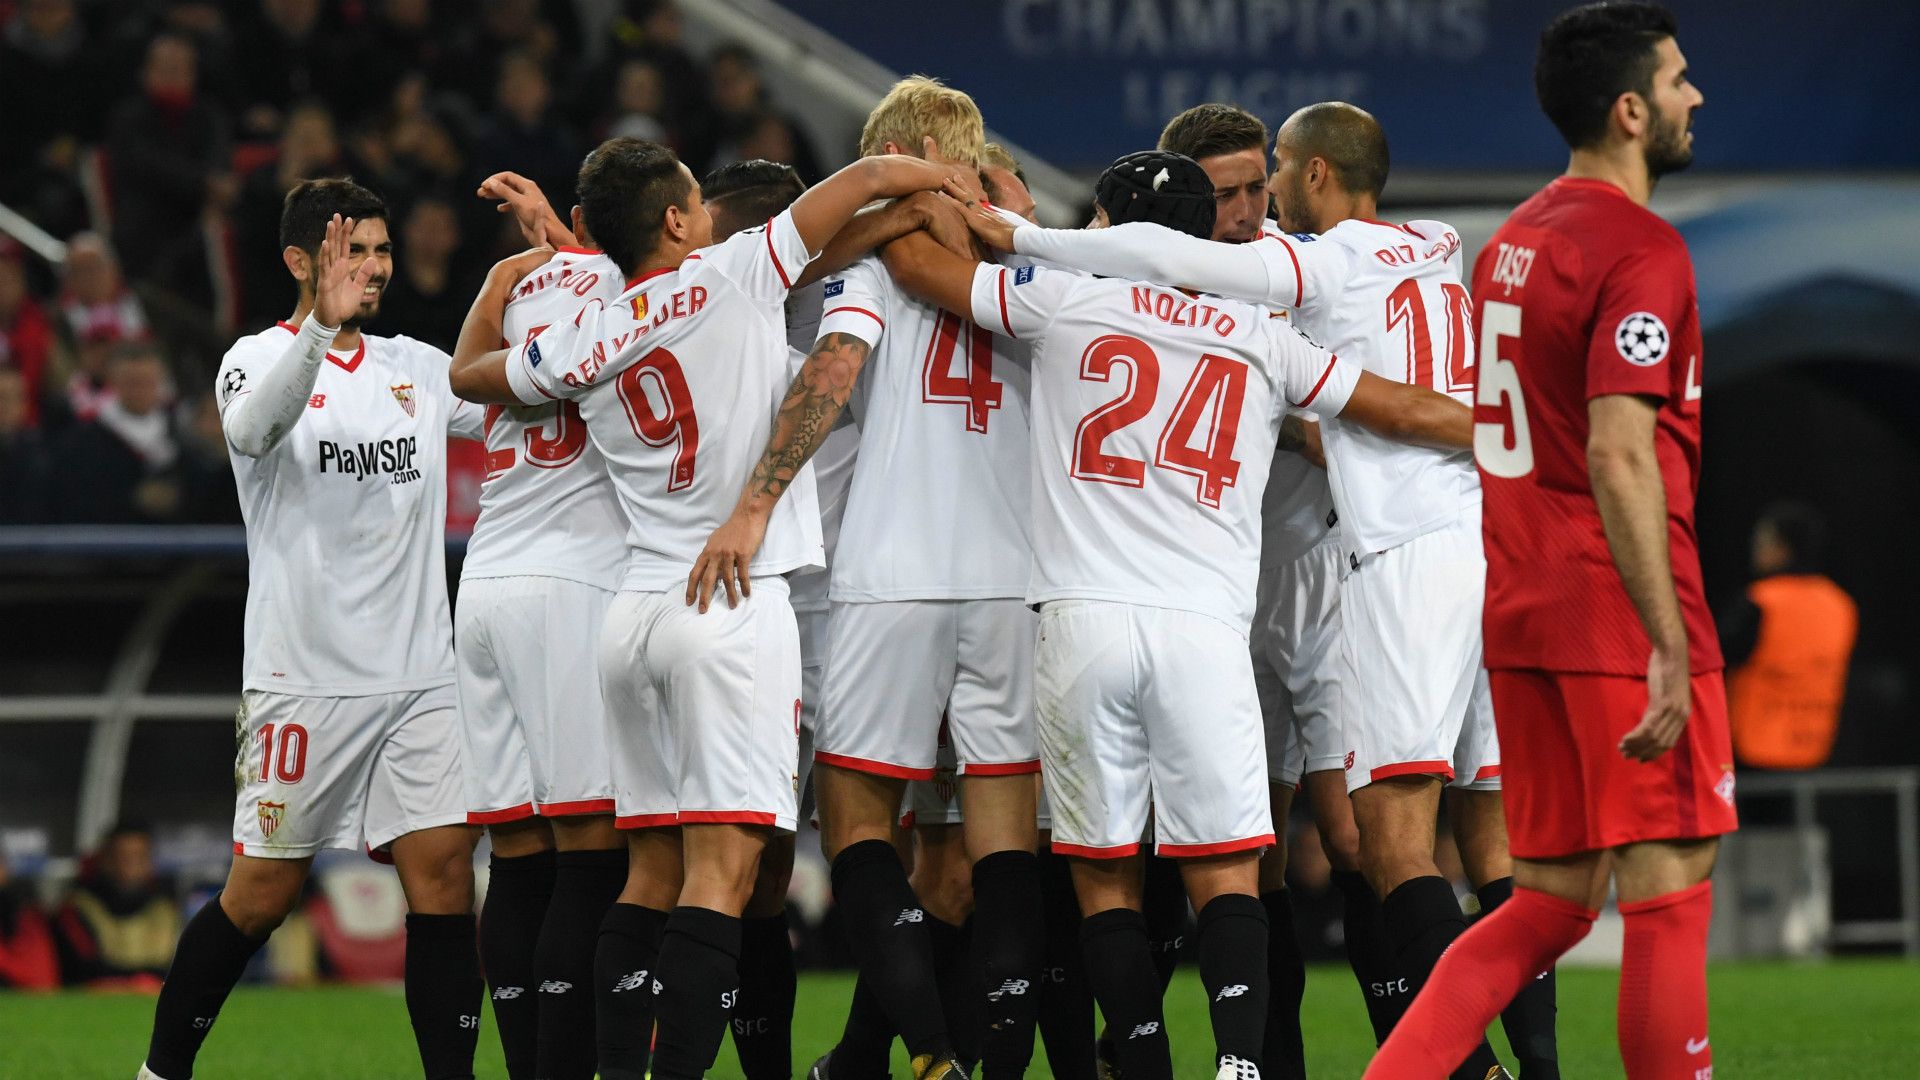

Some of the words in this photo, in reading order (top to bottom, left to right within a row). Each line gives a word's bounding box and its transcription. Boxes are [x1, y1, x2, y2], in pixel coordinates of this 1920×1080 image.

[1001, 0, 1488, 57] CHAMPIONS
[1131, 286, 1236, 337] NOLITO
[922, 307, 1003, 434] 4
[1473, 301, 1534, 478] 5
[616, 346, 700, 493] 9
[1070, 334, 1249, 511] 24
[319, 436, 416, 482] PlayWSOP
[391, 467, 421, 485] .com
[257, 723, 308, 784] 10
[1371, 977, 1409, 998] SFC
